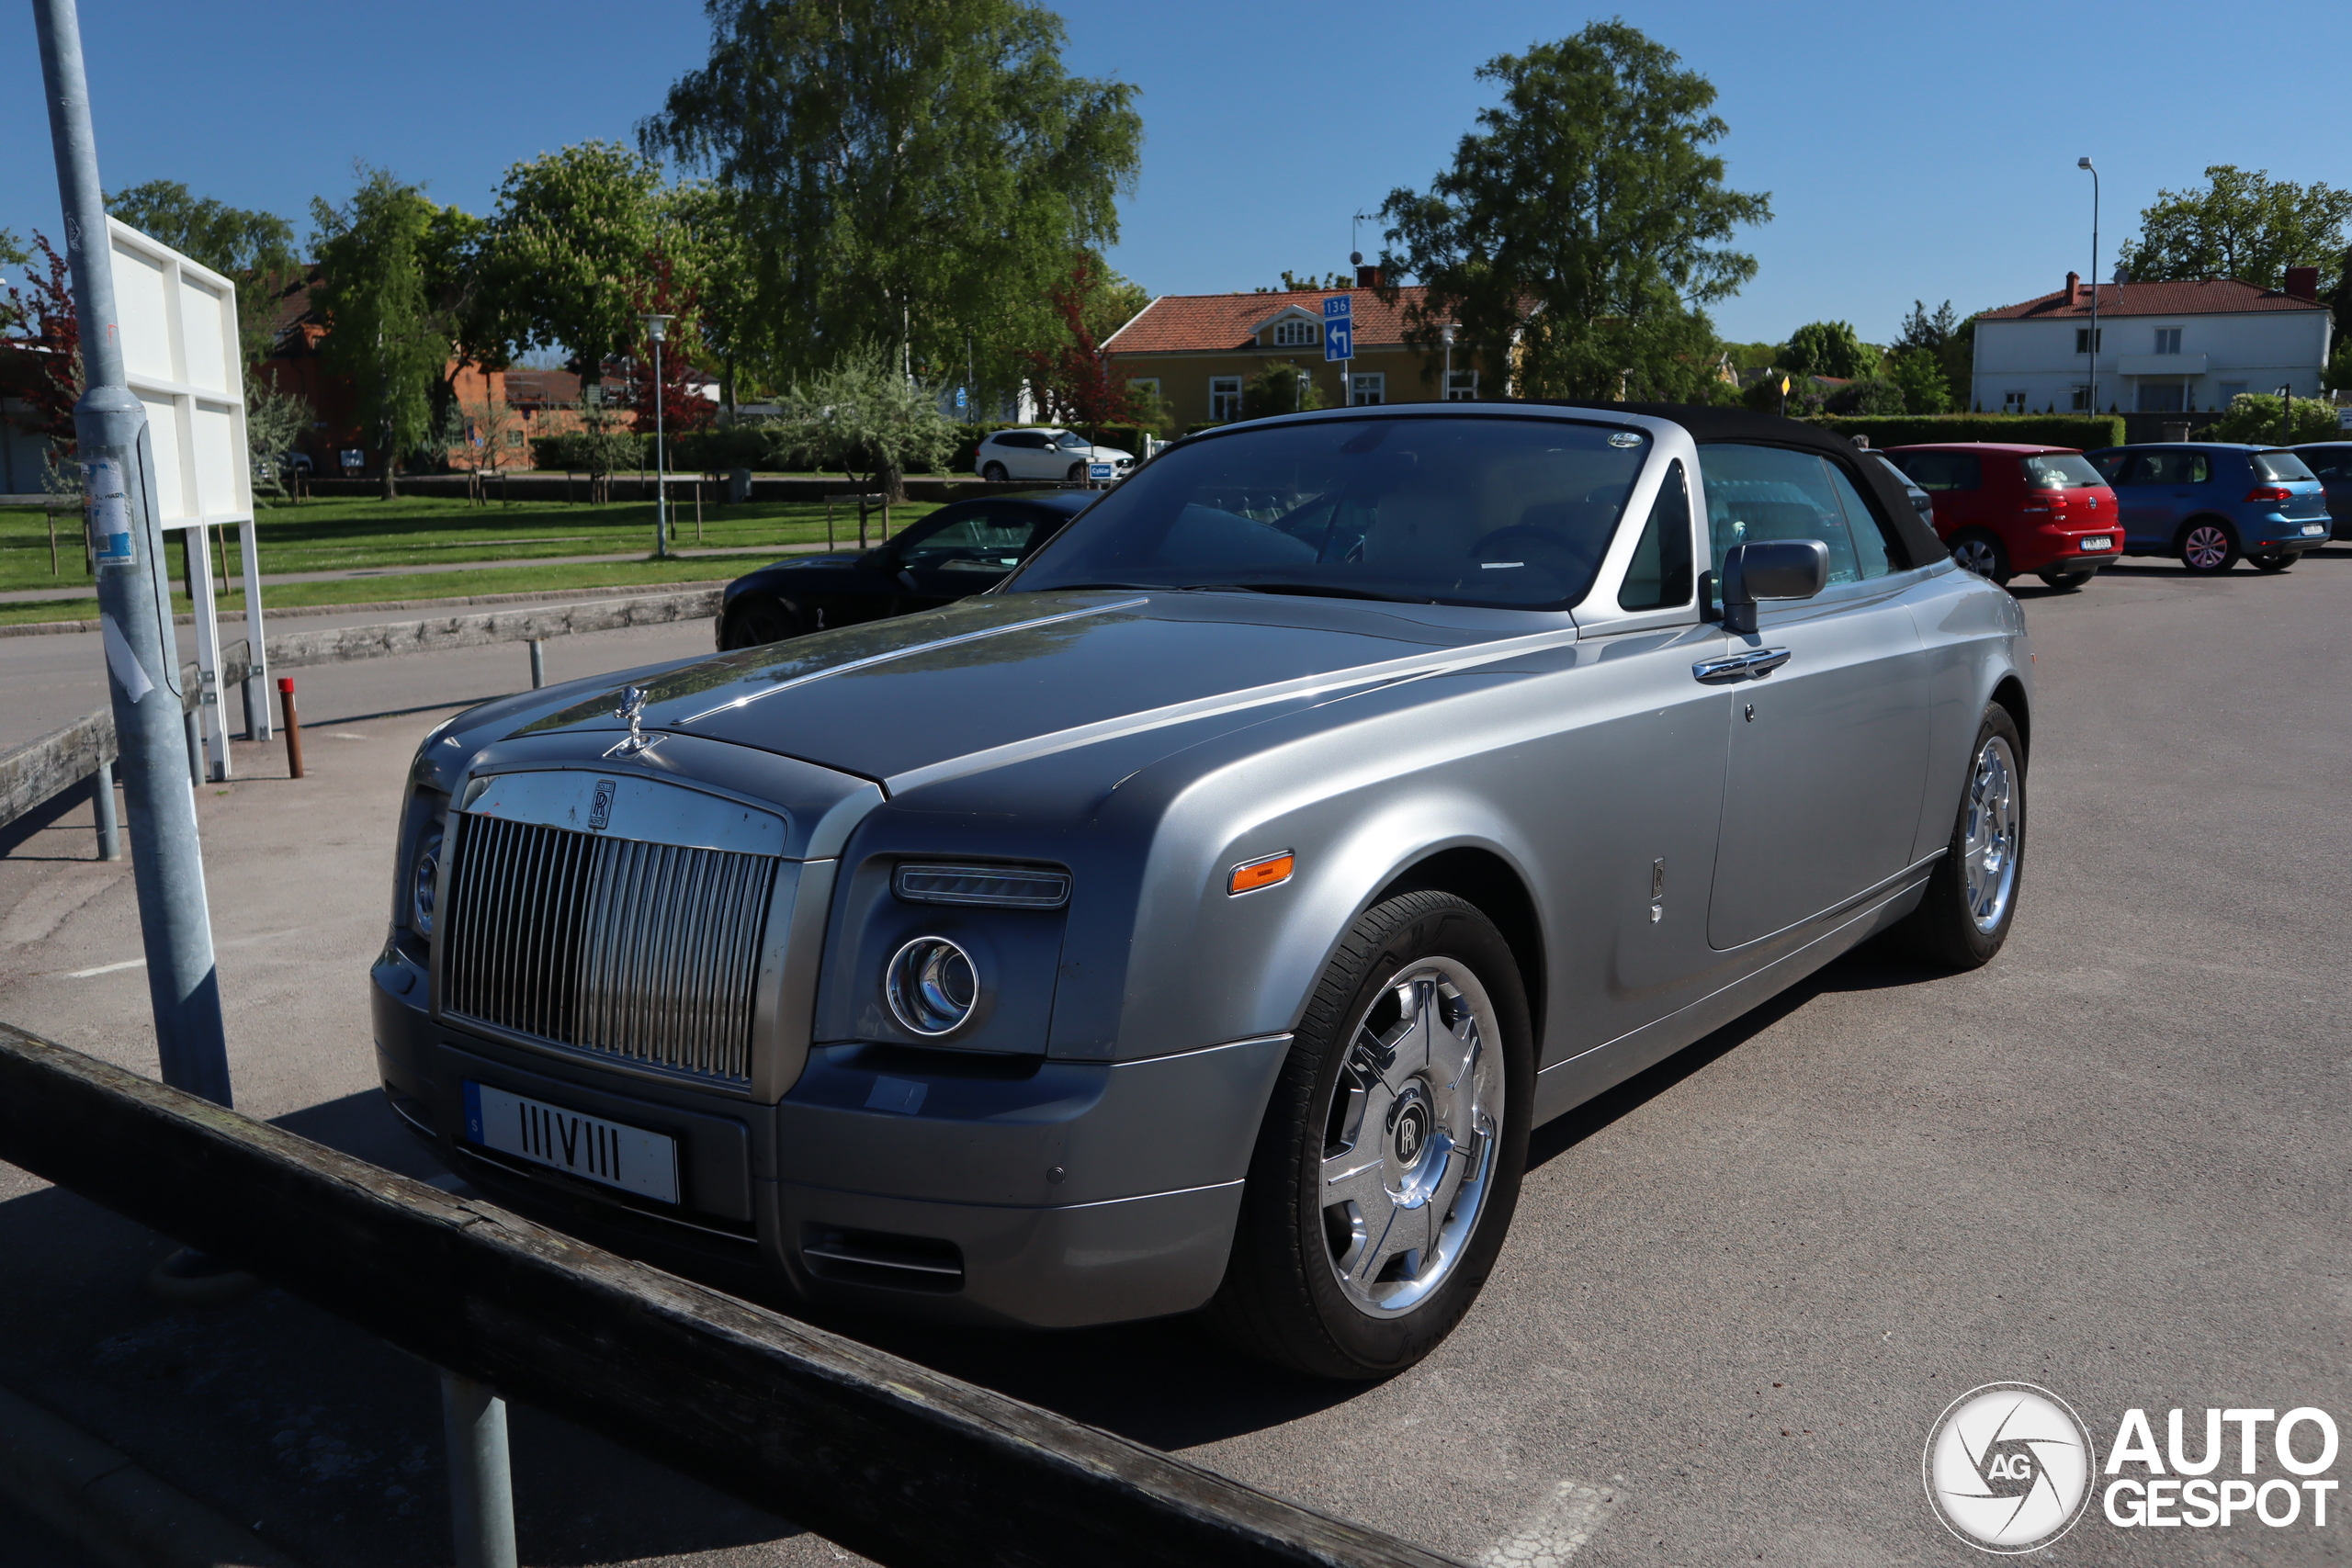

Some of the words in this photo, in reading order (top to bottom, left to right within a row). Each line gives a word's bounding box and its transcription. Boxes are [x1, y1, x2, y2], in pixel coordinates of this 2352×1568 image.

[1327, 299, 1347, 313] 136
[470, 1119, 479, 1133] S
[519, 1102, 621, 1182] IIIVIII
